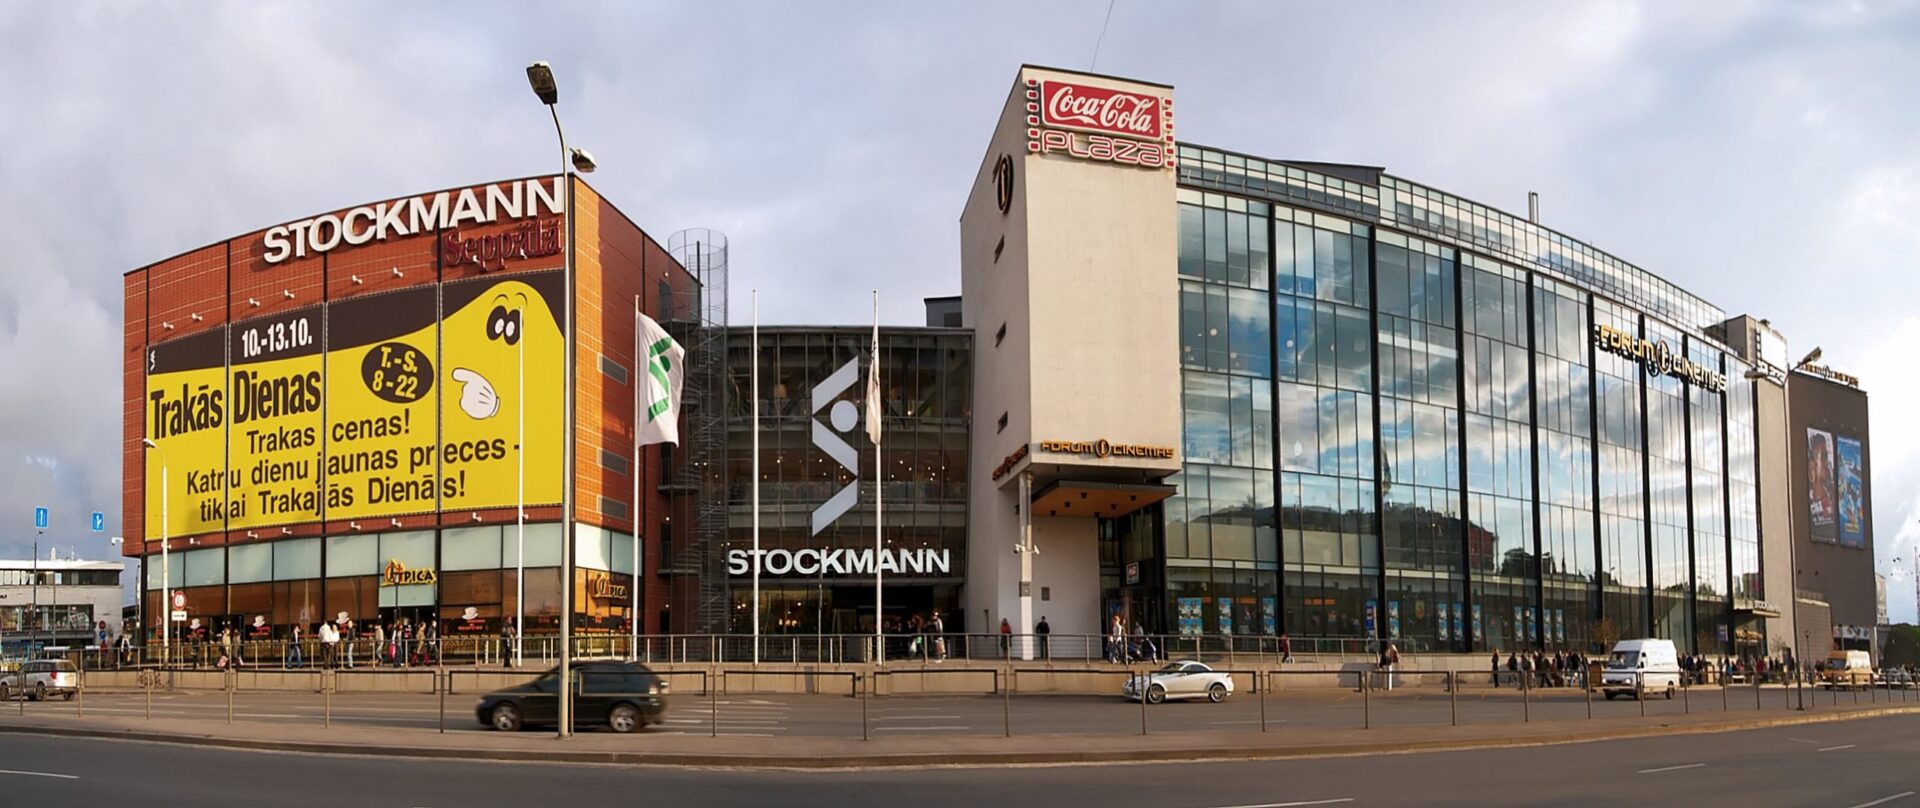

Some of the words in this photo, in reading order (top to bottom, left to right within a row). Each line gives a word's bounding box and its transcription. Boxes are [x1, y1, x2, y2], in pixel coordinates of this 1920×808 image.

[1050, 86, 1155, 133] Coca-Cola
[263, 176, 564, 264] STOCKMANN
[443, 219, 564, 273] Seppälä
[242, 317, 312, 358] 10.-13.10.
[1600, 324, 1657, 362] FORUM
[1672, 354, 1728, 392] CINEMAS
[150, 383, 223, 440] Trakās
[233, 371, 321, 424] Dienas
[246, 426, 316, 455] Trakas
[332, 408, 410, 442] cenas!
[1041, 440, 1093, 453] FORUM
[1112, 444, 1174, 459] CINEMAS
[251, 459, 309, 486] dienu
[315, 449, 399, 485] jaunas
[200, 493, 246, 523] tikai
[258, 483, 354, 517] Trakajās
[367, 470, 466, 504] Dienās!
[728, 548, 950, 575] STOCKMANN
